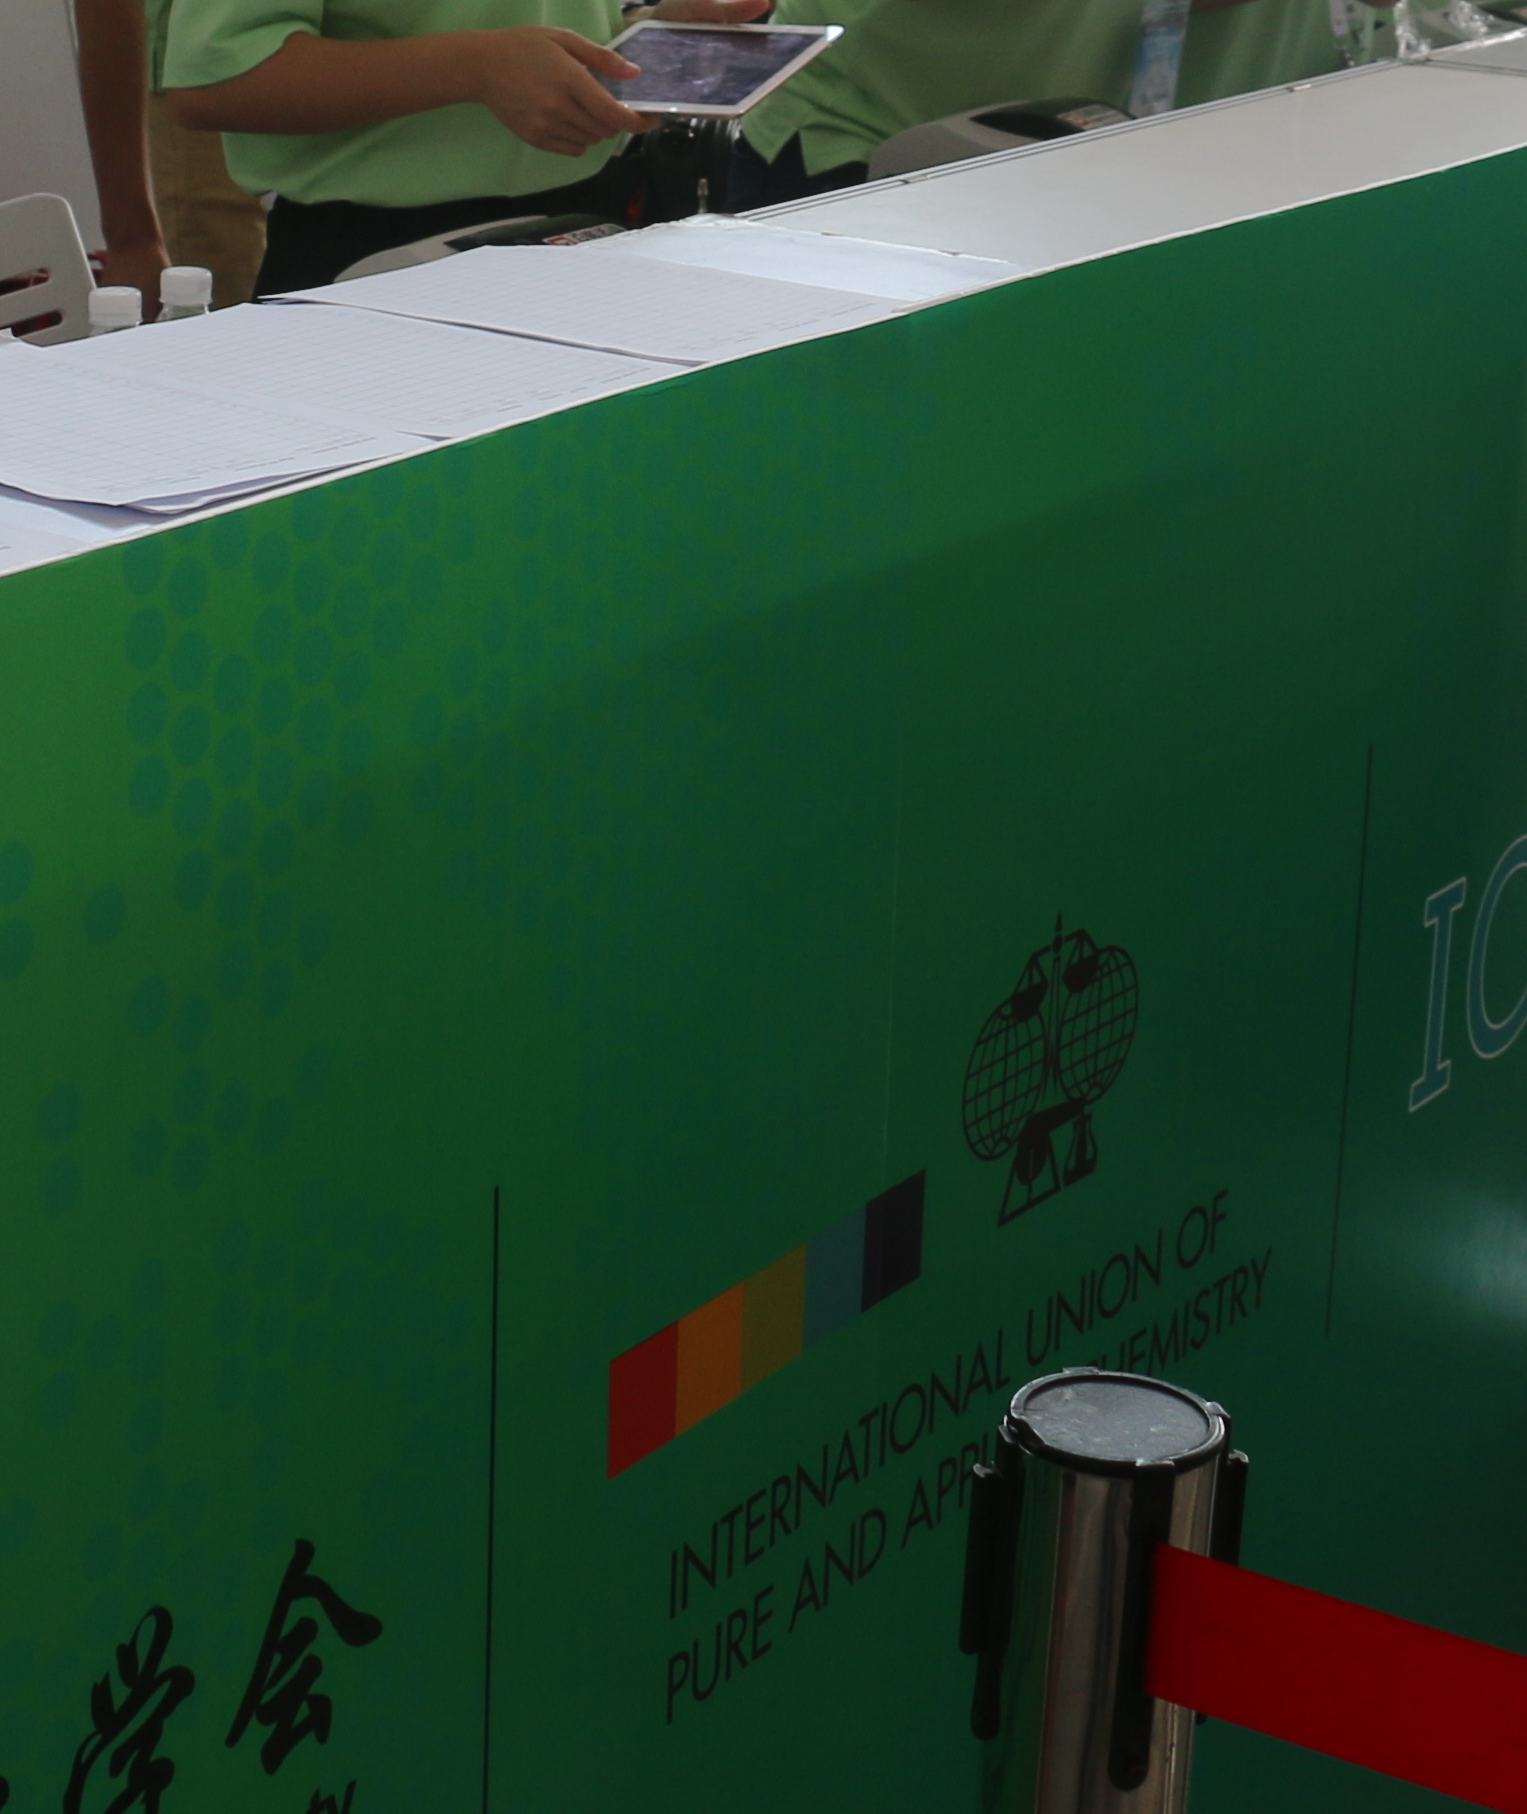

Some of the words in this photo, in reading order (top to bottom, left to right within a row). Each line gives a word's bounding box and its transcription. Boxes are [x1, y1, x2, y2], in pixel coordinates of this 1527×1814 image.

[666, 1325, 1012, 1622] INTERNATIONAL
[1023, 1227, 1164, 1368] UNION
[1174, 1188, 1230, 1271] OF
[664, 1585, 776, 1726] PURE
[787, 1508, 888, 1636] AND
